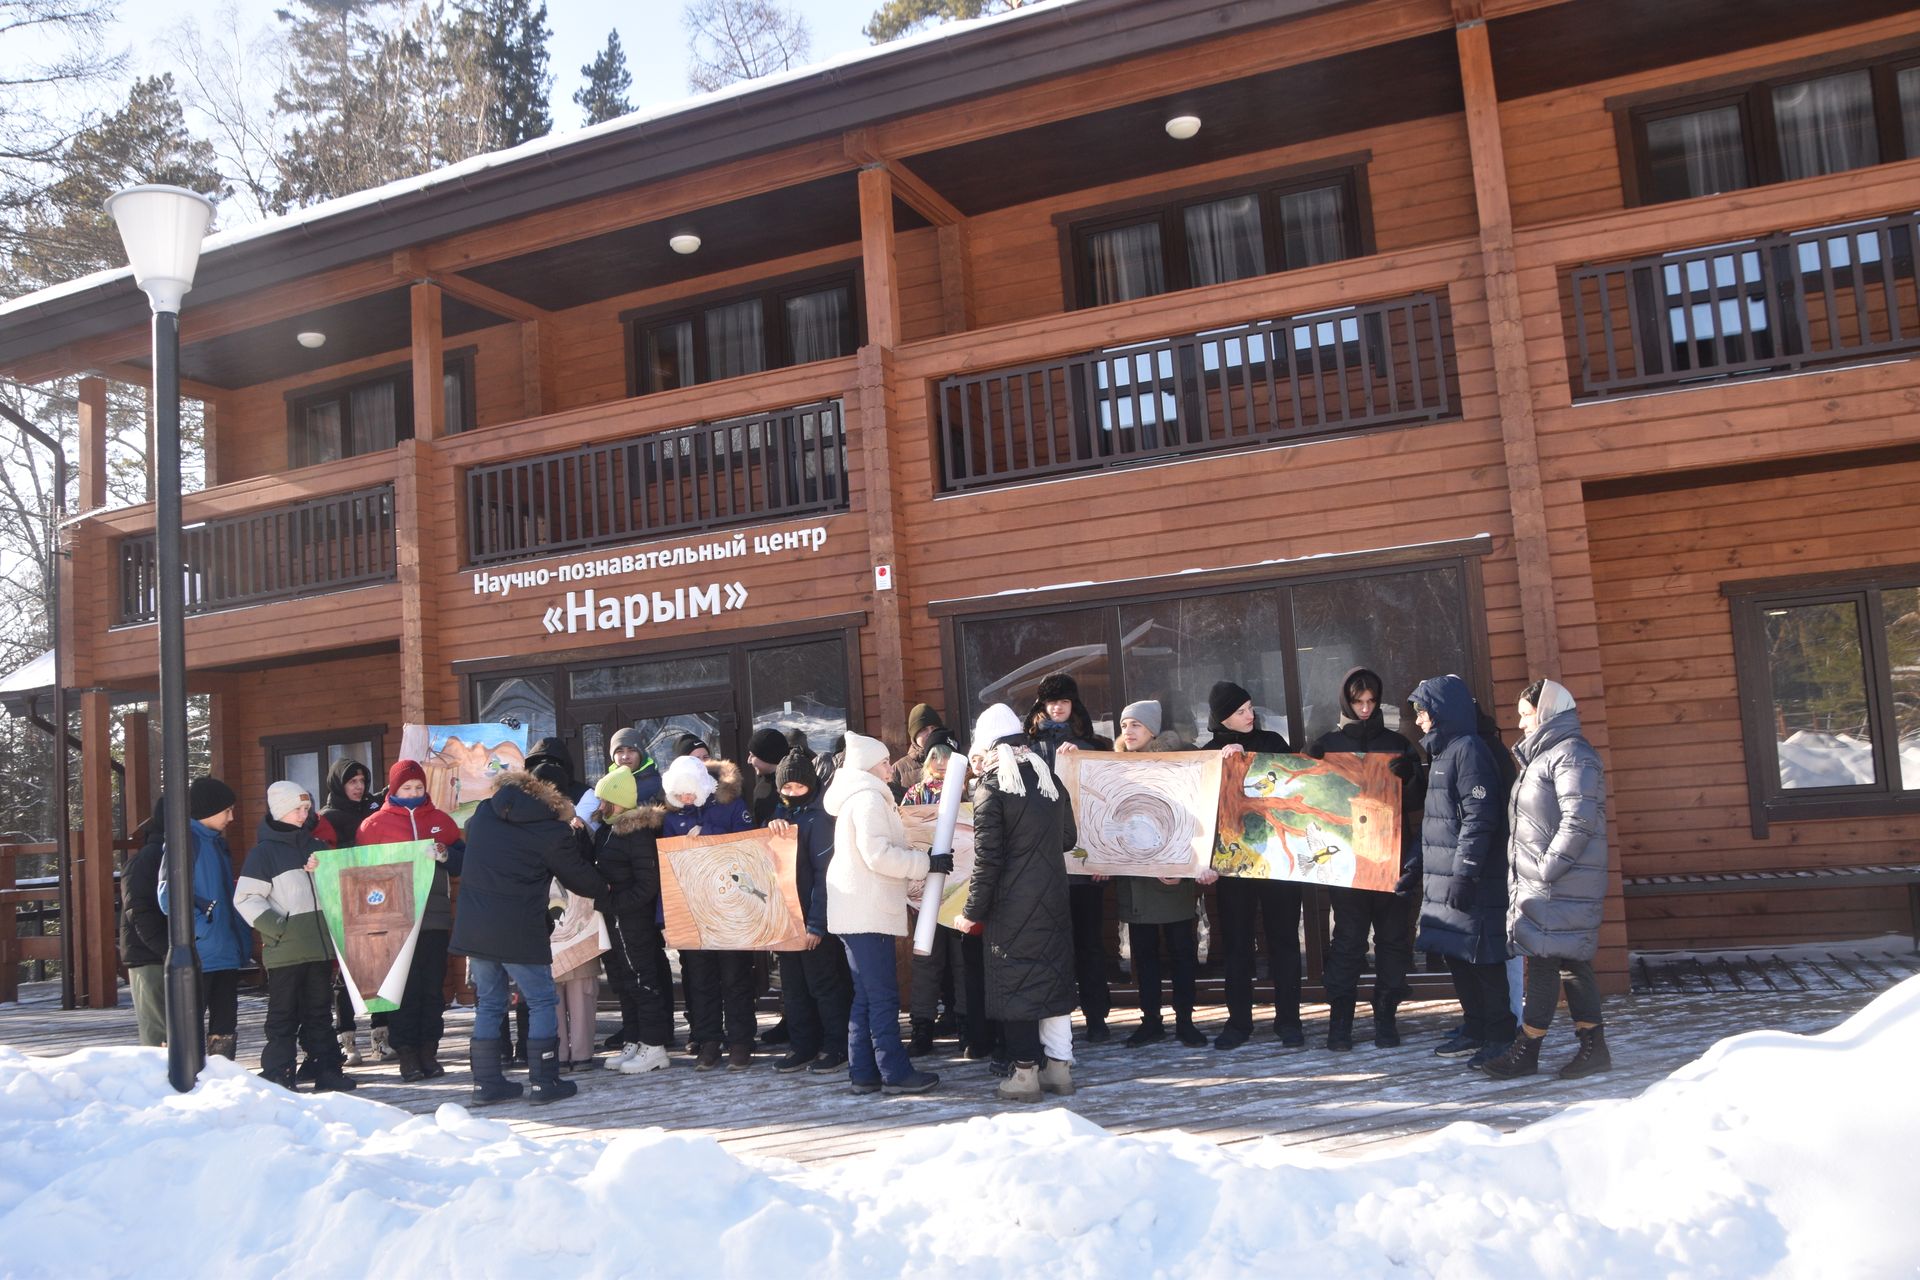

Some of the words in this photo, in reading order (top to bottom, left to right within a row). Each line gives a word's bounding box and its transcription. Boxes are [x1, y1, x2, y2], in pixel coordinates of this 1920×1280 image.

[473, 533, 747, 597] Научно-познавательный
[753, 526, 828, 556] центр
[542, 580, 749, 639] «Нарым»
